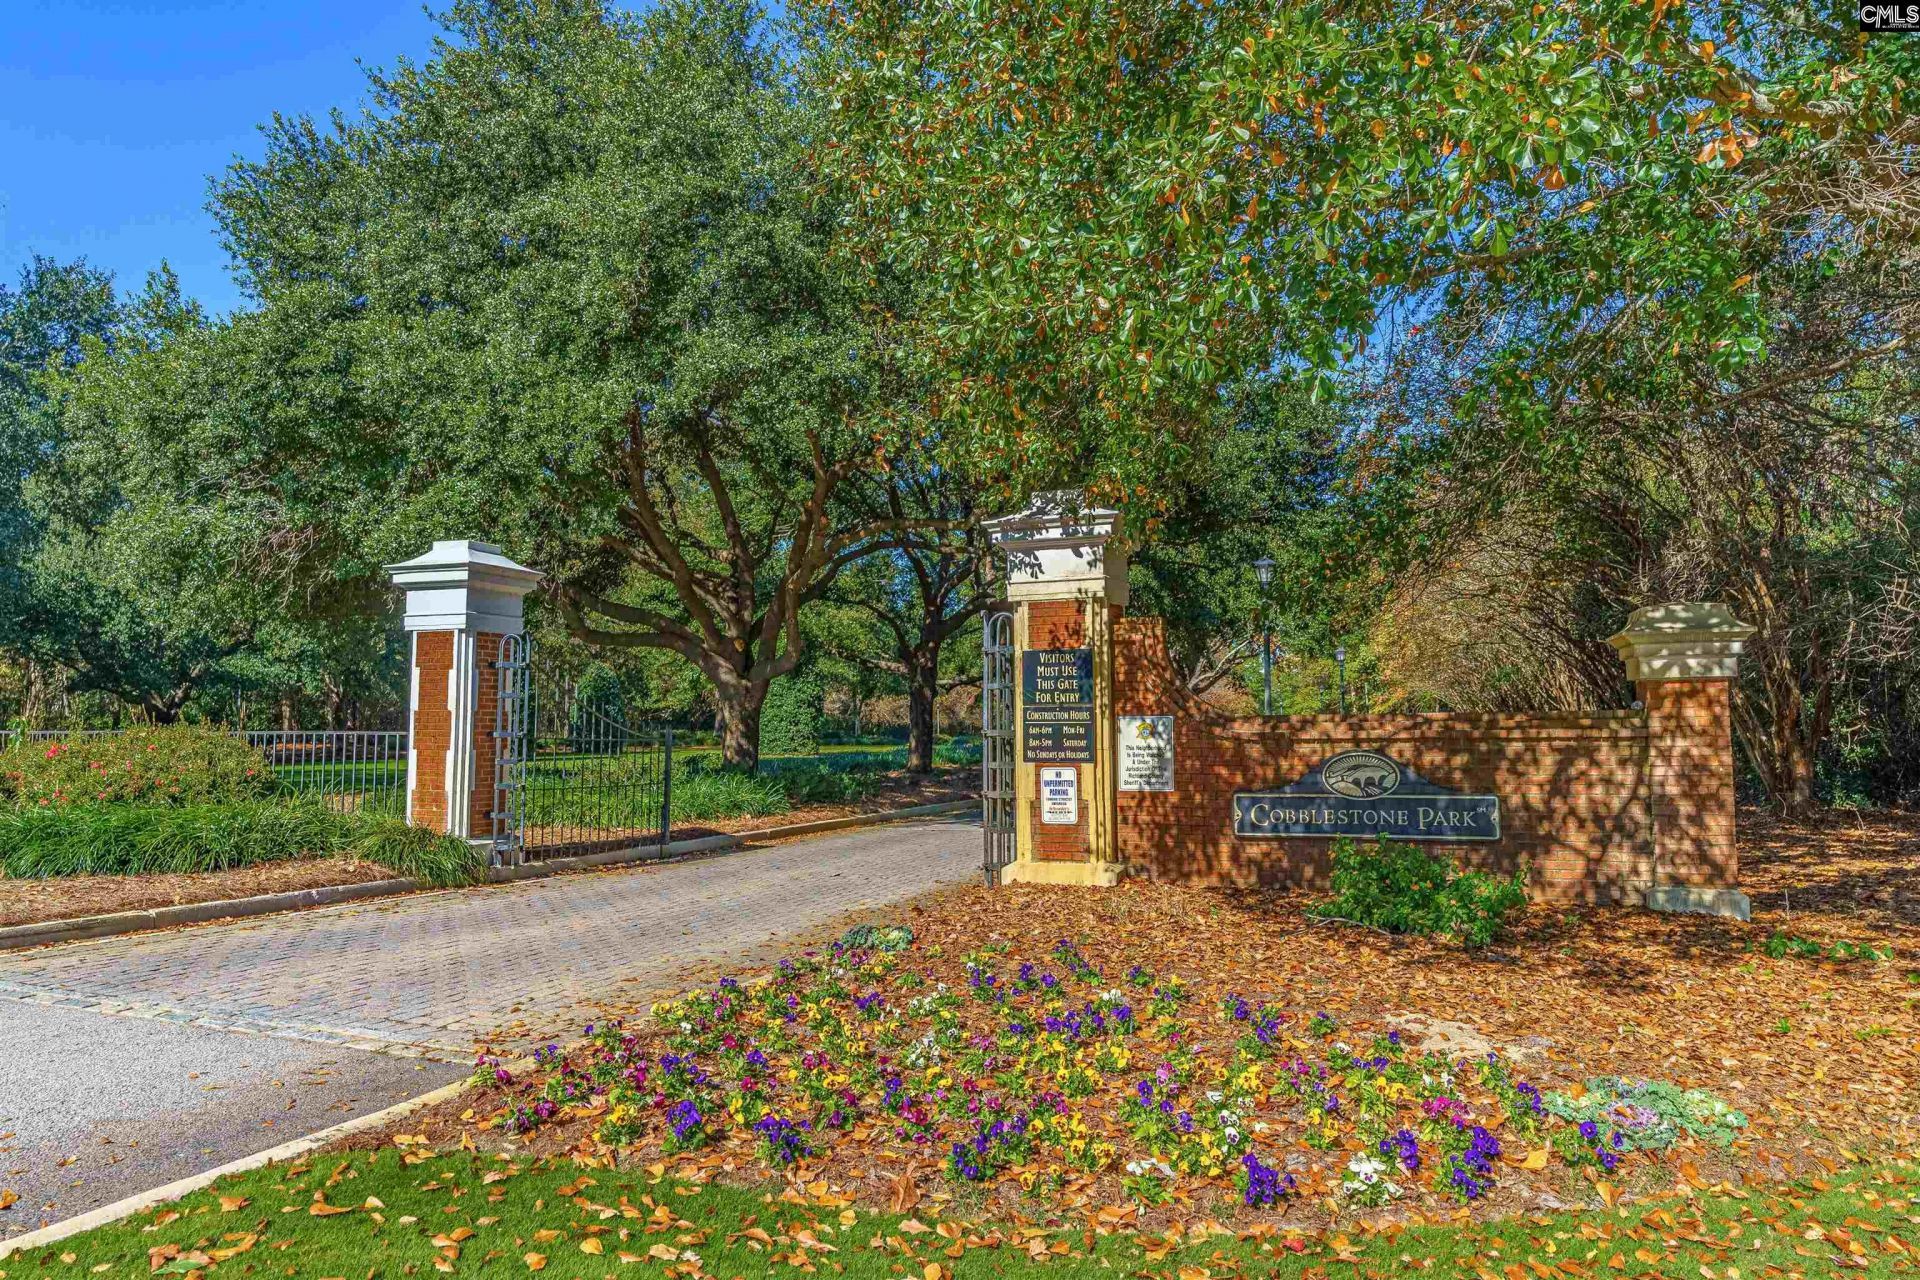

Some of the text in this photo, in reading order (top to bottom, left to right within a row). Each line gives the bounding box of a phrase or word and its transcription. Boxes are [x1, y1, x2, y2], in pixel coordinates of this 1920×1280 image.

[1040, 652, 1074, 663] VISITORS
[1037, 666, 1077, 676] MUST USE
[1036, 679, 1078, 689] THIS GATE
[1036, 692, 1080, 702] FOR ENTRY
[1026, 710, 1090, 720] CONSTRUCTION HOURS
[1027, 750, 1035, 758] NO
[1037, 750, 1057, 758] SUNDAYS
[1066, 750, 1090, 758] HOLIDAYS
[1250, 804, 1408, 826] COBBLESTONE
[1416, 807, 1476, 830] PARK
